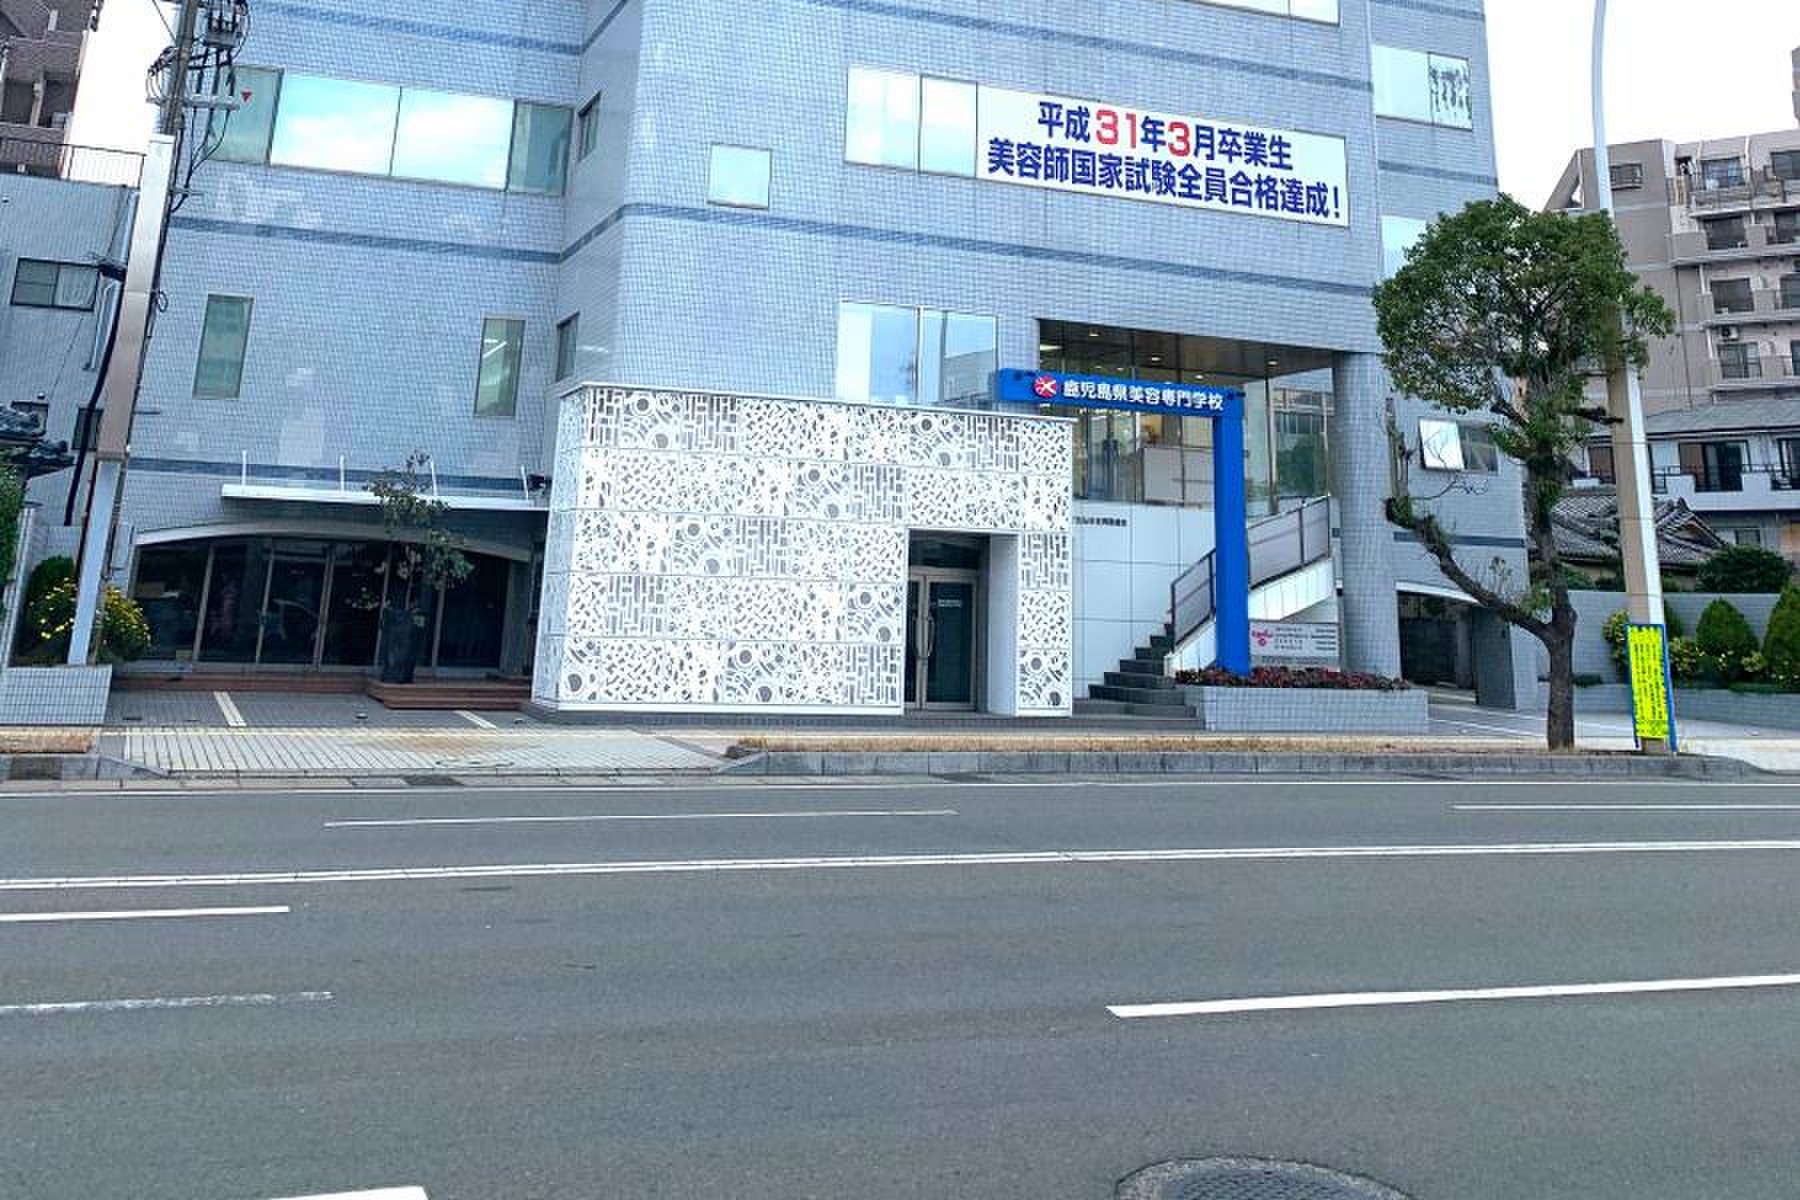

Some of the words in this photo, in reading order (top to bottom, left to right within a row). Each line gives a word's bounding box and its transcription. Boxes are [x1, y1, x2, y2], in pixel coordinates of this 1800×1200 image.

[1037, 101, 1294, 171] 平成31年3月卒業生
[1063, 379, 1224, 411] 鹿児島県美容専門学校
